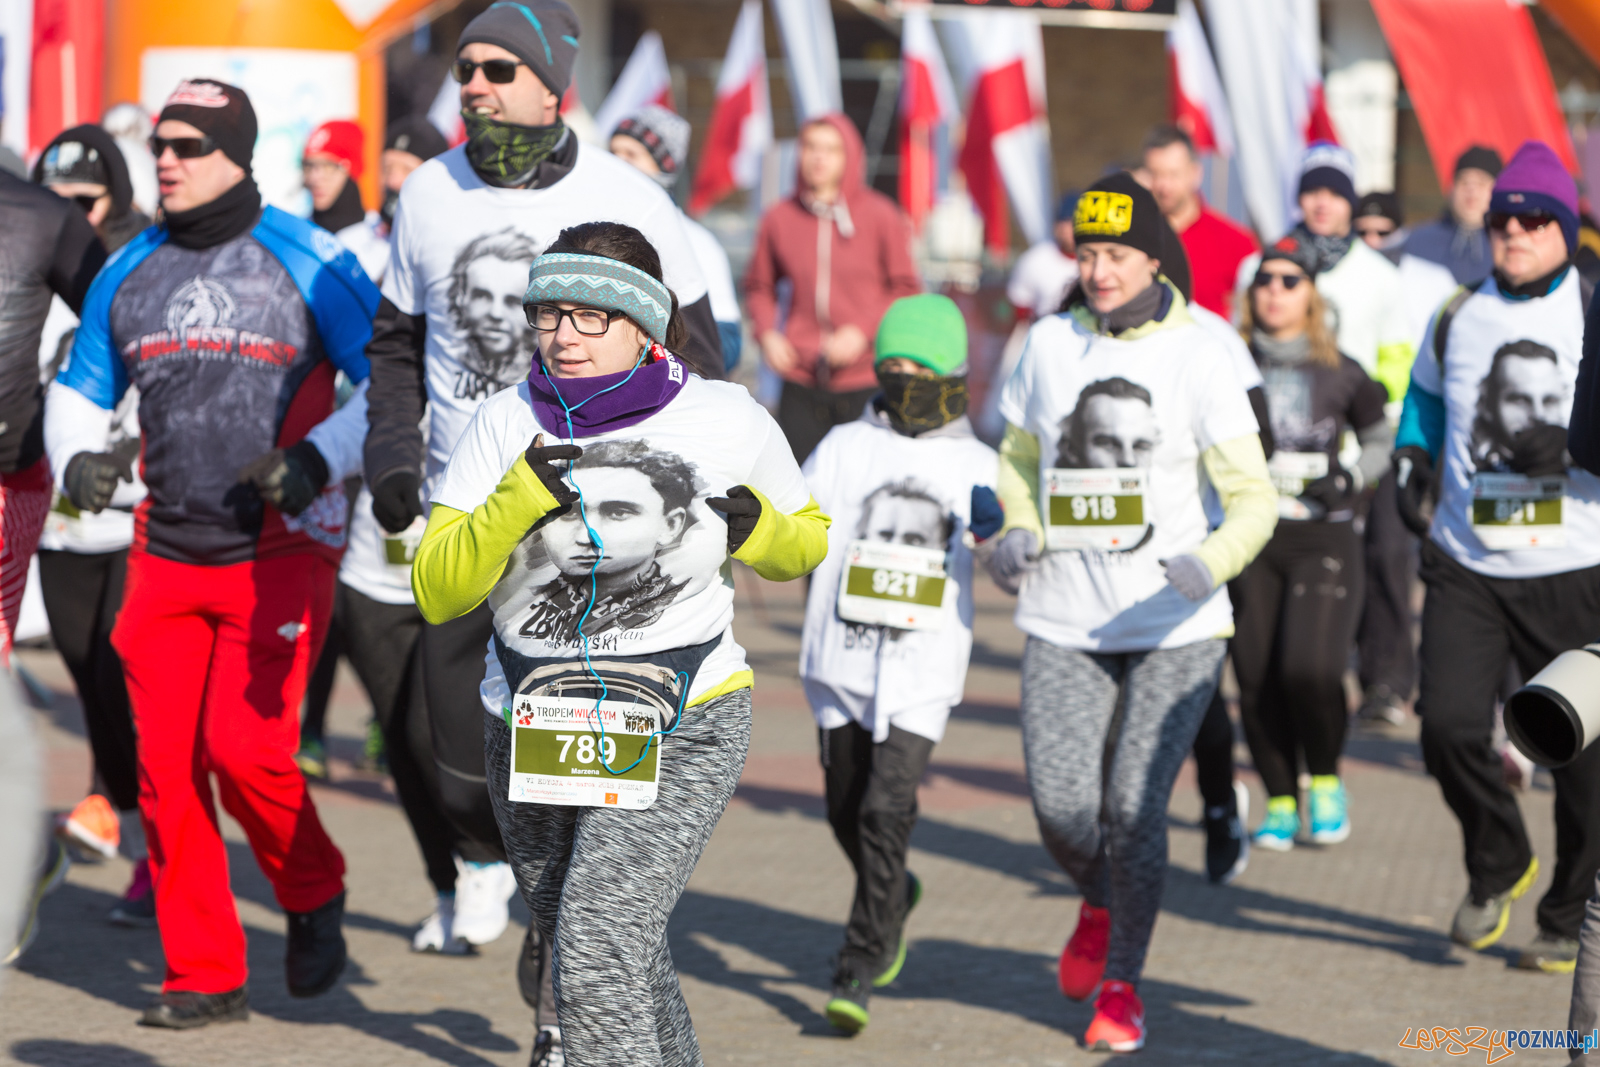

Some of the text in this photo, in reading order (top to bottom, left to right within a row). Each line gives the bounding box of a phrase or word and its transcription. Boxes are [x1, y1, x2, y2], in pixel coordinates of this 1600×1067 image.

[186, 326, 236, 353] WEST
[239, 330, 297, 367] COAST
[1071, 495, 1117, 520] 918
[872, 568, 918, 598] 921
[555, 734, 617, 765] 789
[538, 778, 563, 787] EDYCJA
[571, 767, 600, 775] Marzena
